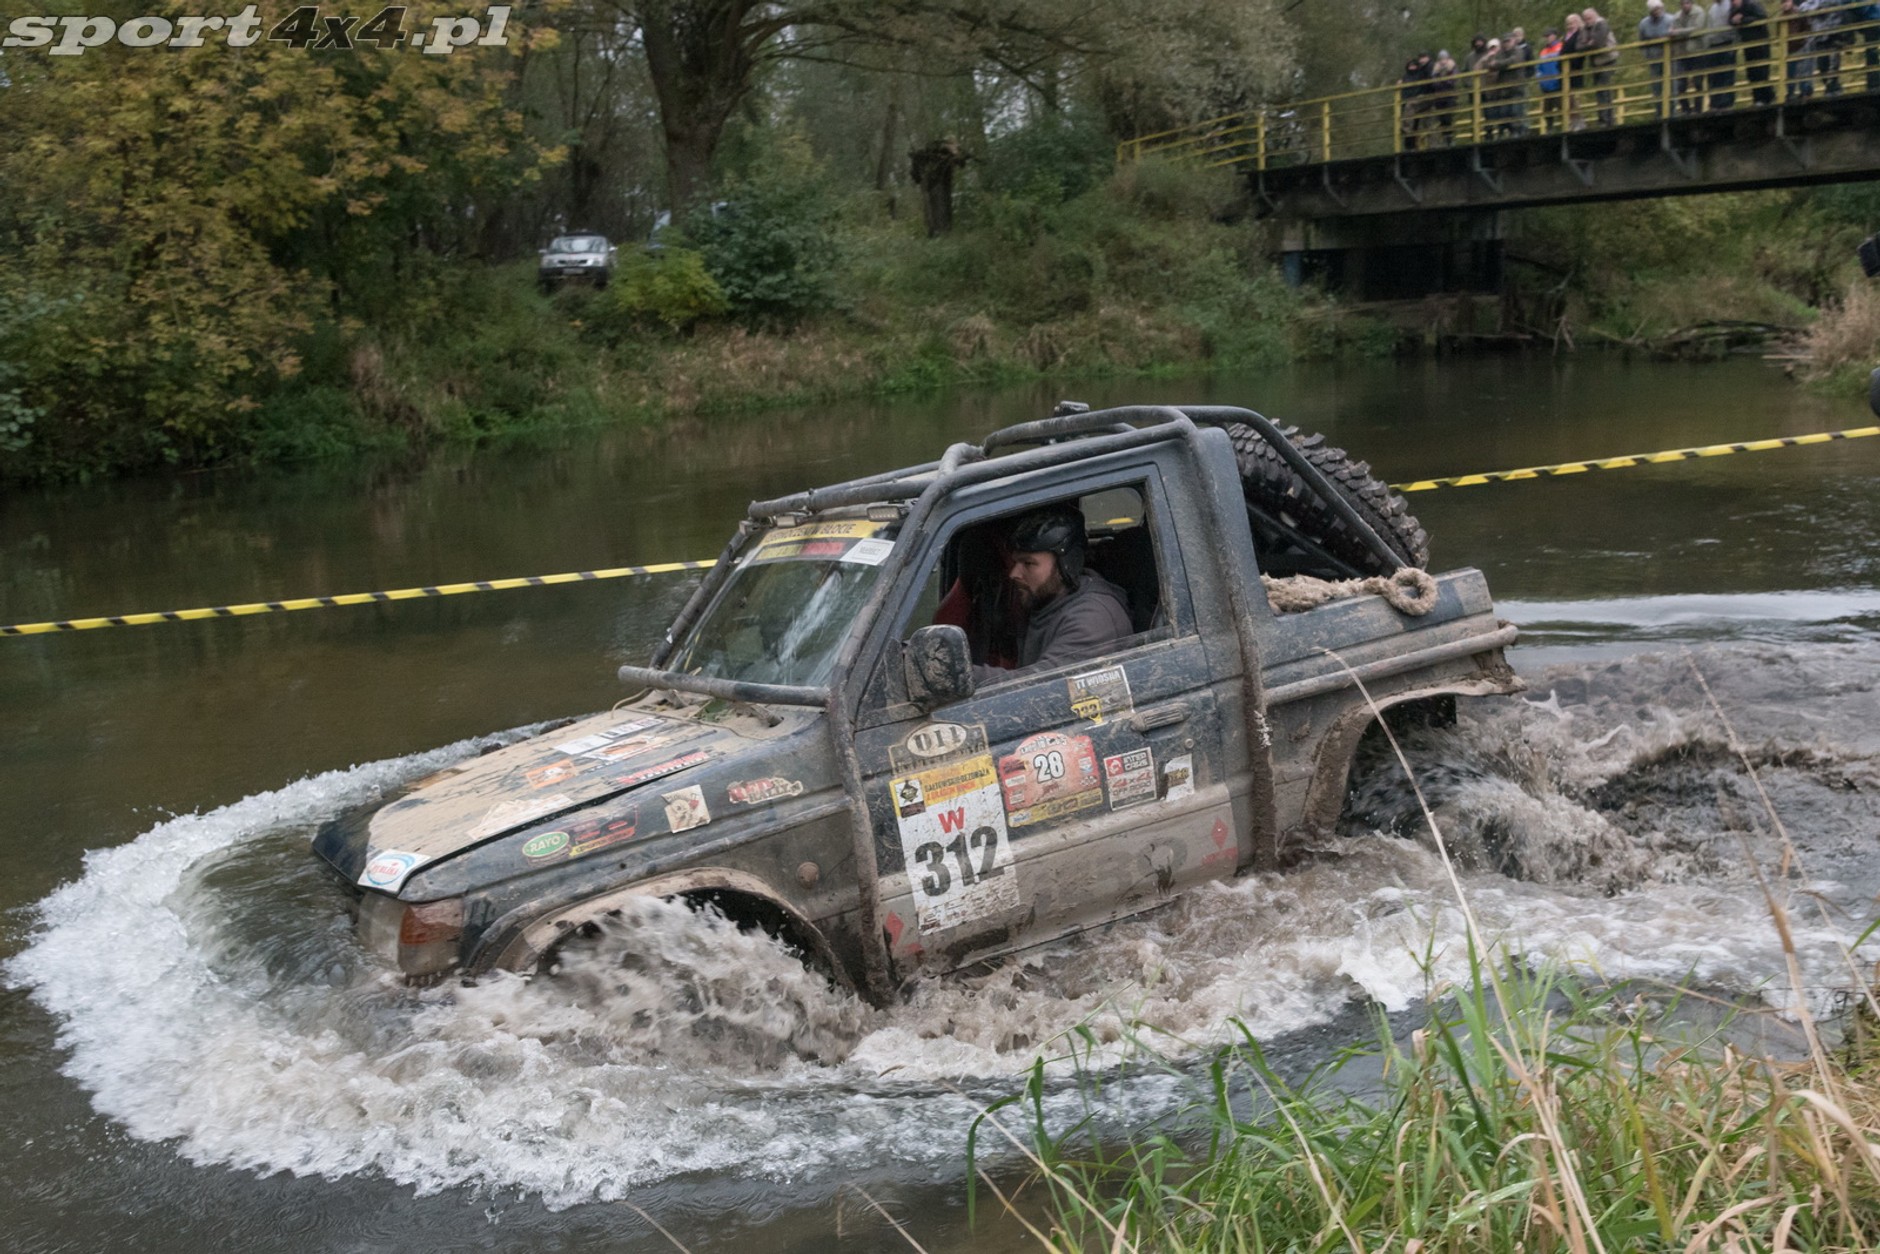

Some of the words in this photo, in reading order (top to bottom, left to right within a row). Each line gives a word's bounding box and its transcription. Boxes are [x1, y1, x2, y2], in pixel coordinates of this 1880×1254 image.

[1033, 750, 1066, 784] 28
[937, 806, 965, 833] W
[529, 835, 561, 853] RAYO
[914, 825, 1005, 897] 312
